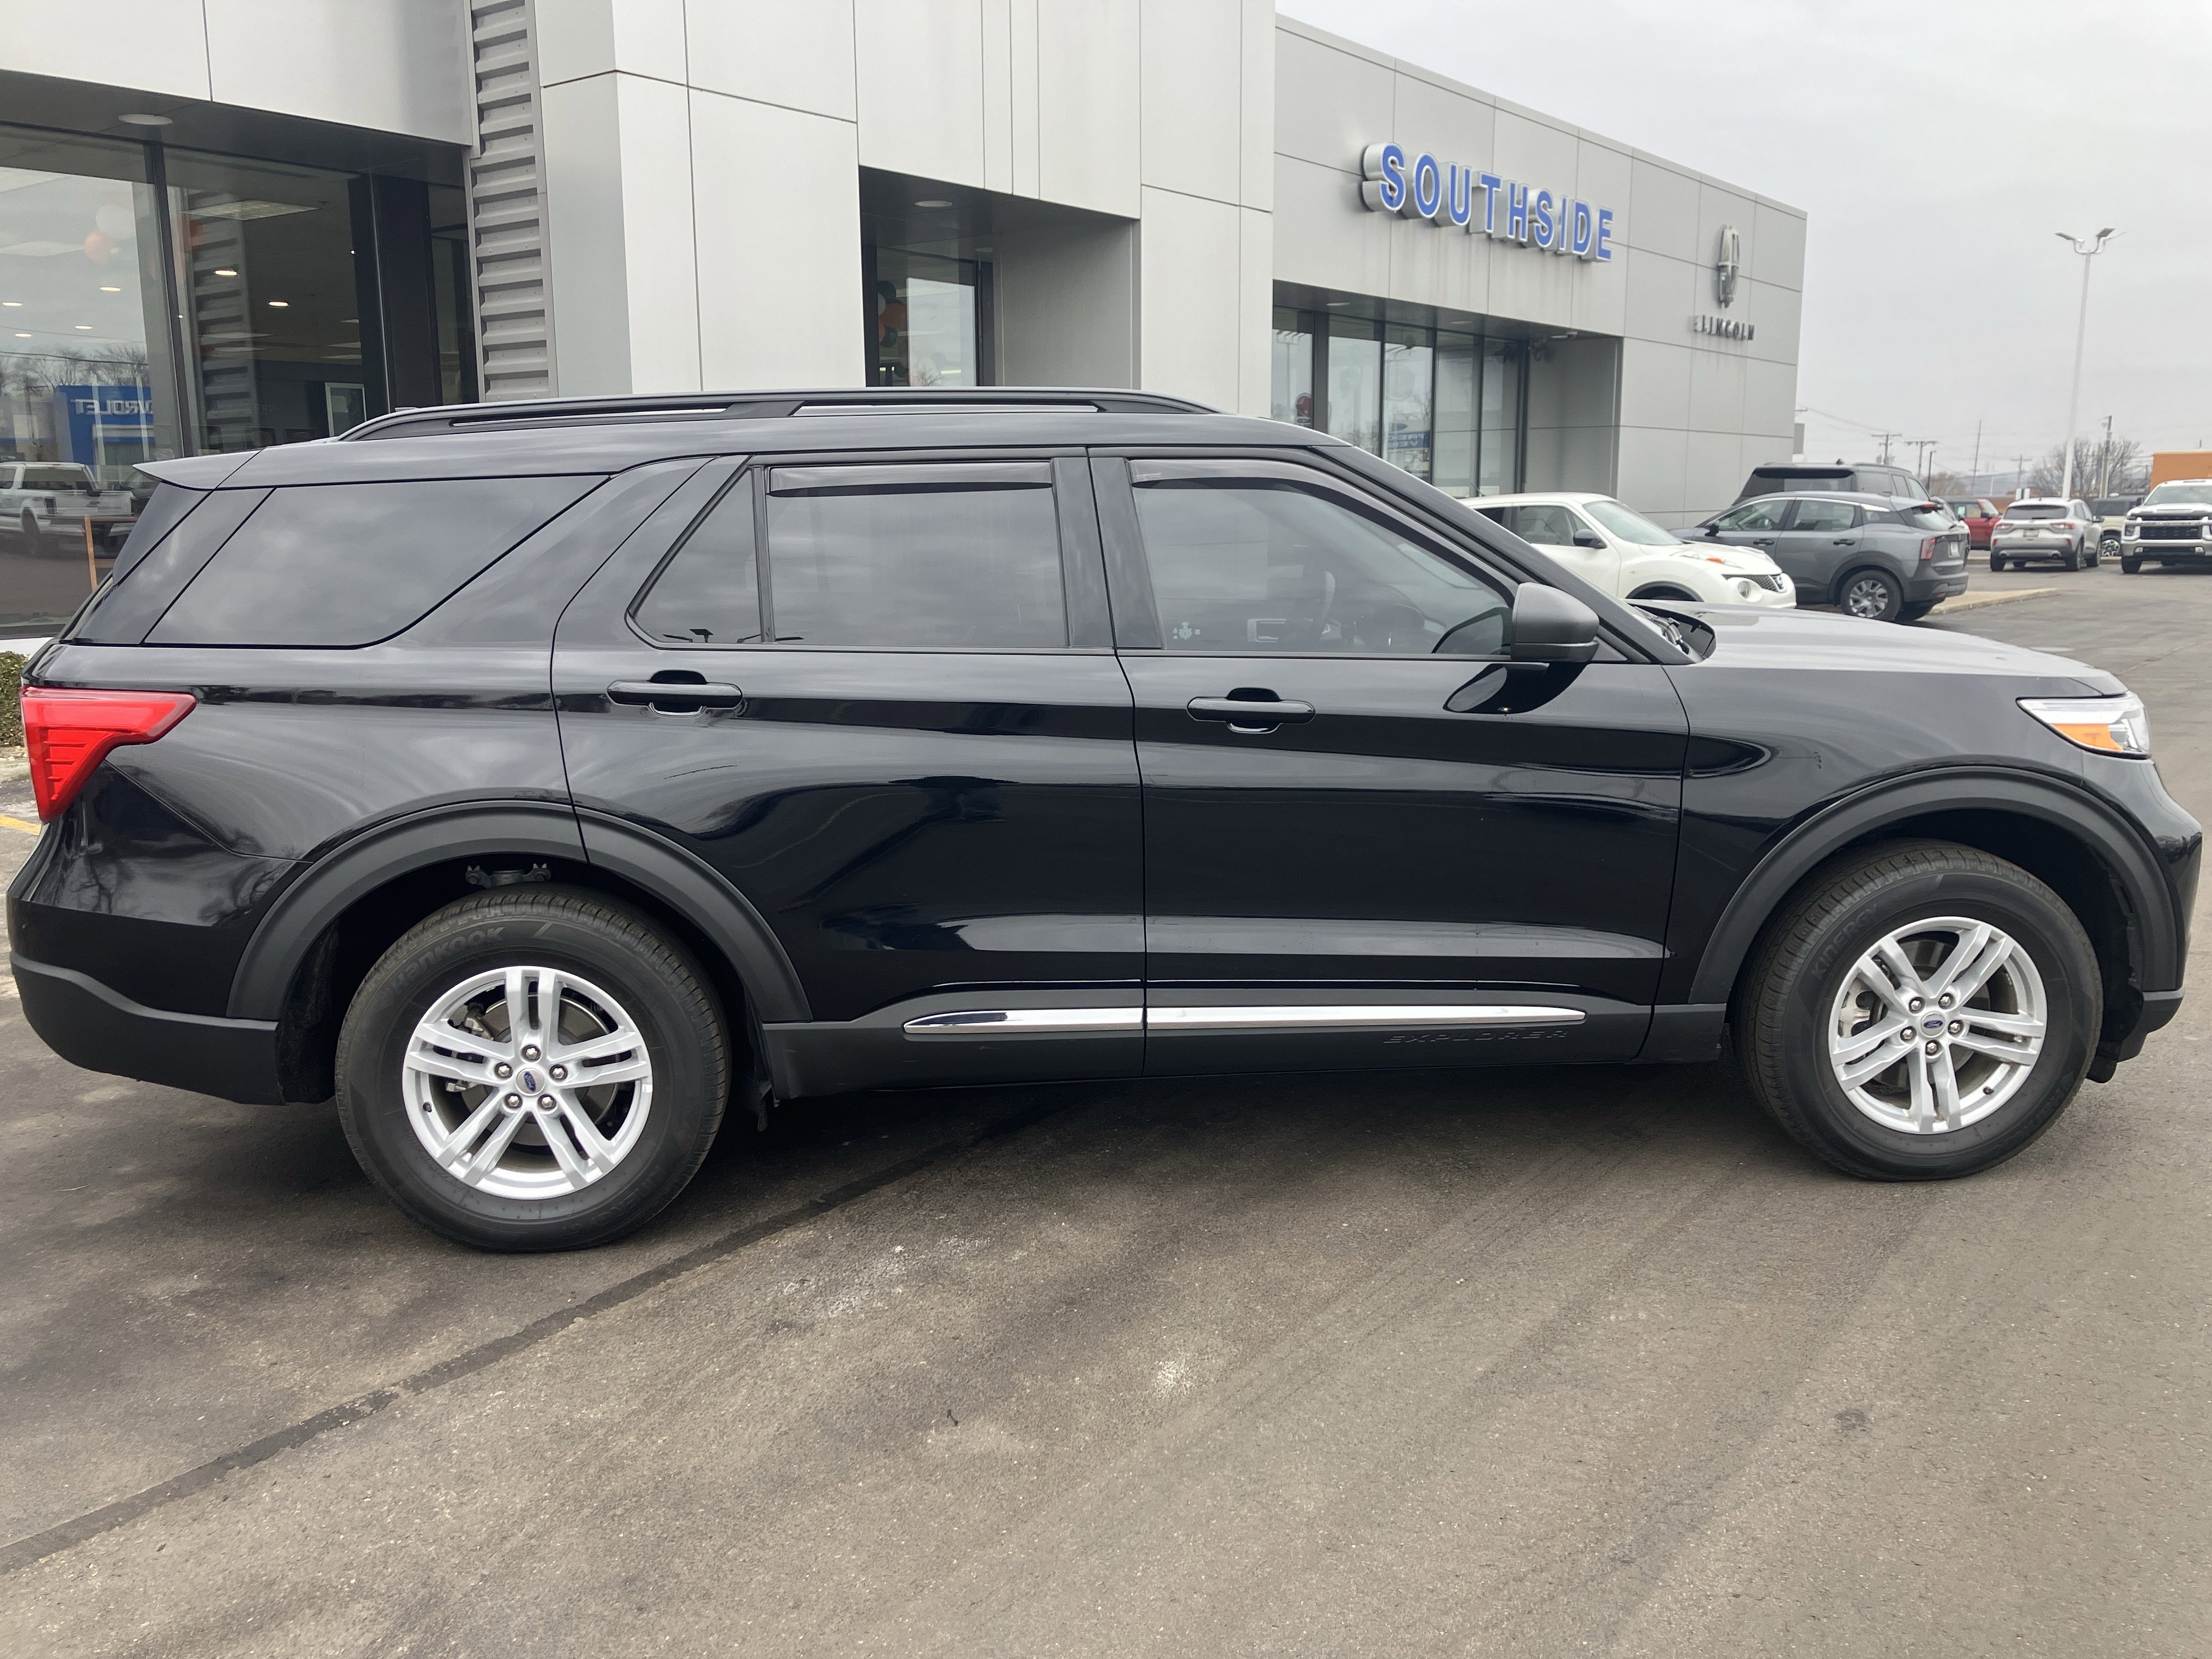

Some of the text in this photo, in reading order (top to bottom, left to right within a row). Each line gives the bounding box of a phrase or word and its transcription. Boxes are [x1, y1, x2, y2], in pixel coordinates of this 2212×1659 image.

[1378, 142, 1613, 262] SOUTHSIDE
[1700, 314, 1754, 341] LINCOLN
[1383, 1030, 1568, 1043] EXPLORER
